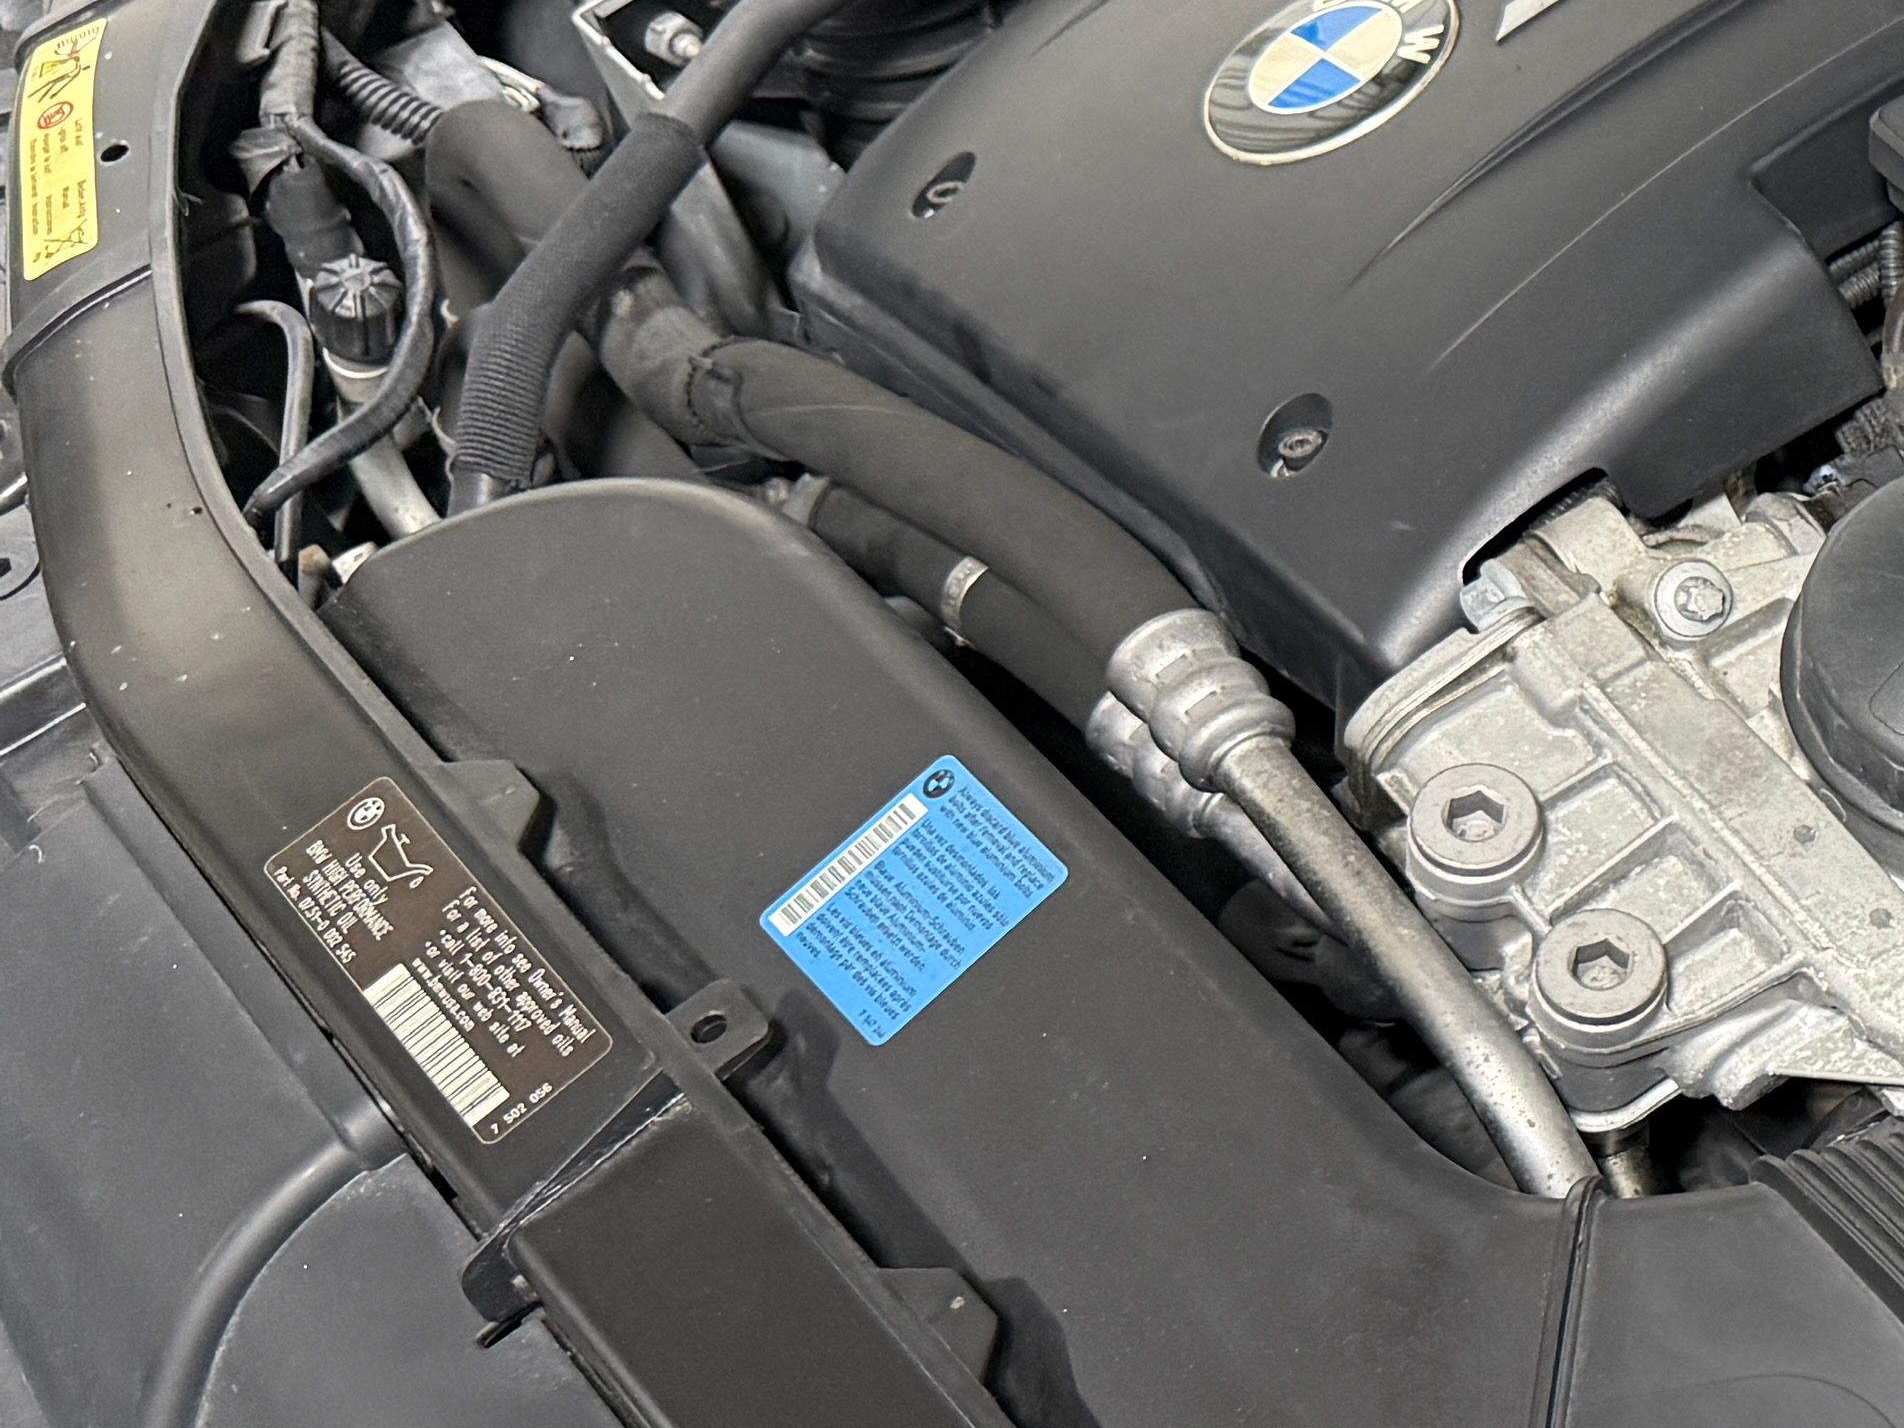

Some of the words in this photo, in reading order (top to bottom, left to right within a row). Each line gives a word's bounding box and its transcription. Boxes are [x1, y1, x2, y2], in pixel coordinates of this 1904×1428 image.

[302, 869, 346, 916] SYNTHETIC
[335, 911, 358, 934] OIL
[305, 839, 332, 864] BMW
[321, 858, 349, 886] HIGH
[339, 879, 393, 940] PERFORMANCE
[344, 851, 366, 878] Use
[362, 878, 388, 905] only
[272, 865, 295, 887] Part
[286, 882, 301, 901] No.
[297, 896, 330, 931] 07.51-0
[322, 926, 343, 948] 002
[334, 942, 357, 964] 545
[441, 898, 462, 922] For
[455, 920, 470, 933] a
[458, 885, 478, 909] For
[473, 907, 498, 934] more
[493, 928, 517, 954] info
[510, 952, 532, 973] see
[527, 967, 564, 1009] Owner's
[558, 1003, 596, 1043] Manual
[464, 926, 490, 952] list
[480, 950, 503, 971] of
[411, 957, 474, 1031] www.bmwusa.com
[425, 945, 441, 958] or
[437, 958, 464, 984] visit
[456, 982, 475, 1000] our
[472, 1000, 494, 1022] web
[487, 1020, 510, 1044] site
[505, 1042, 525, 1058] at
[440, 933, 465, 956] call
[459, 952, 531, 1031] 1-800-831-1117
[489, 964, 520, 994] other
[515, 990, 561, 1035] approved
[550, 1033, 574, 1057] oils
[489, 1122, 499, 1135] 7
[502, 1101, 527, 1124] 502
[528, 1081, 553, 1103] 056
